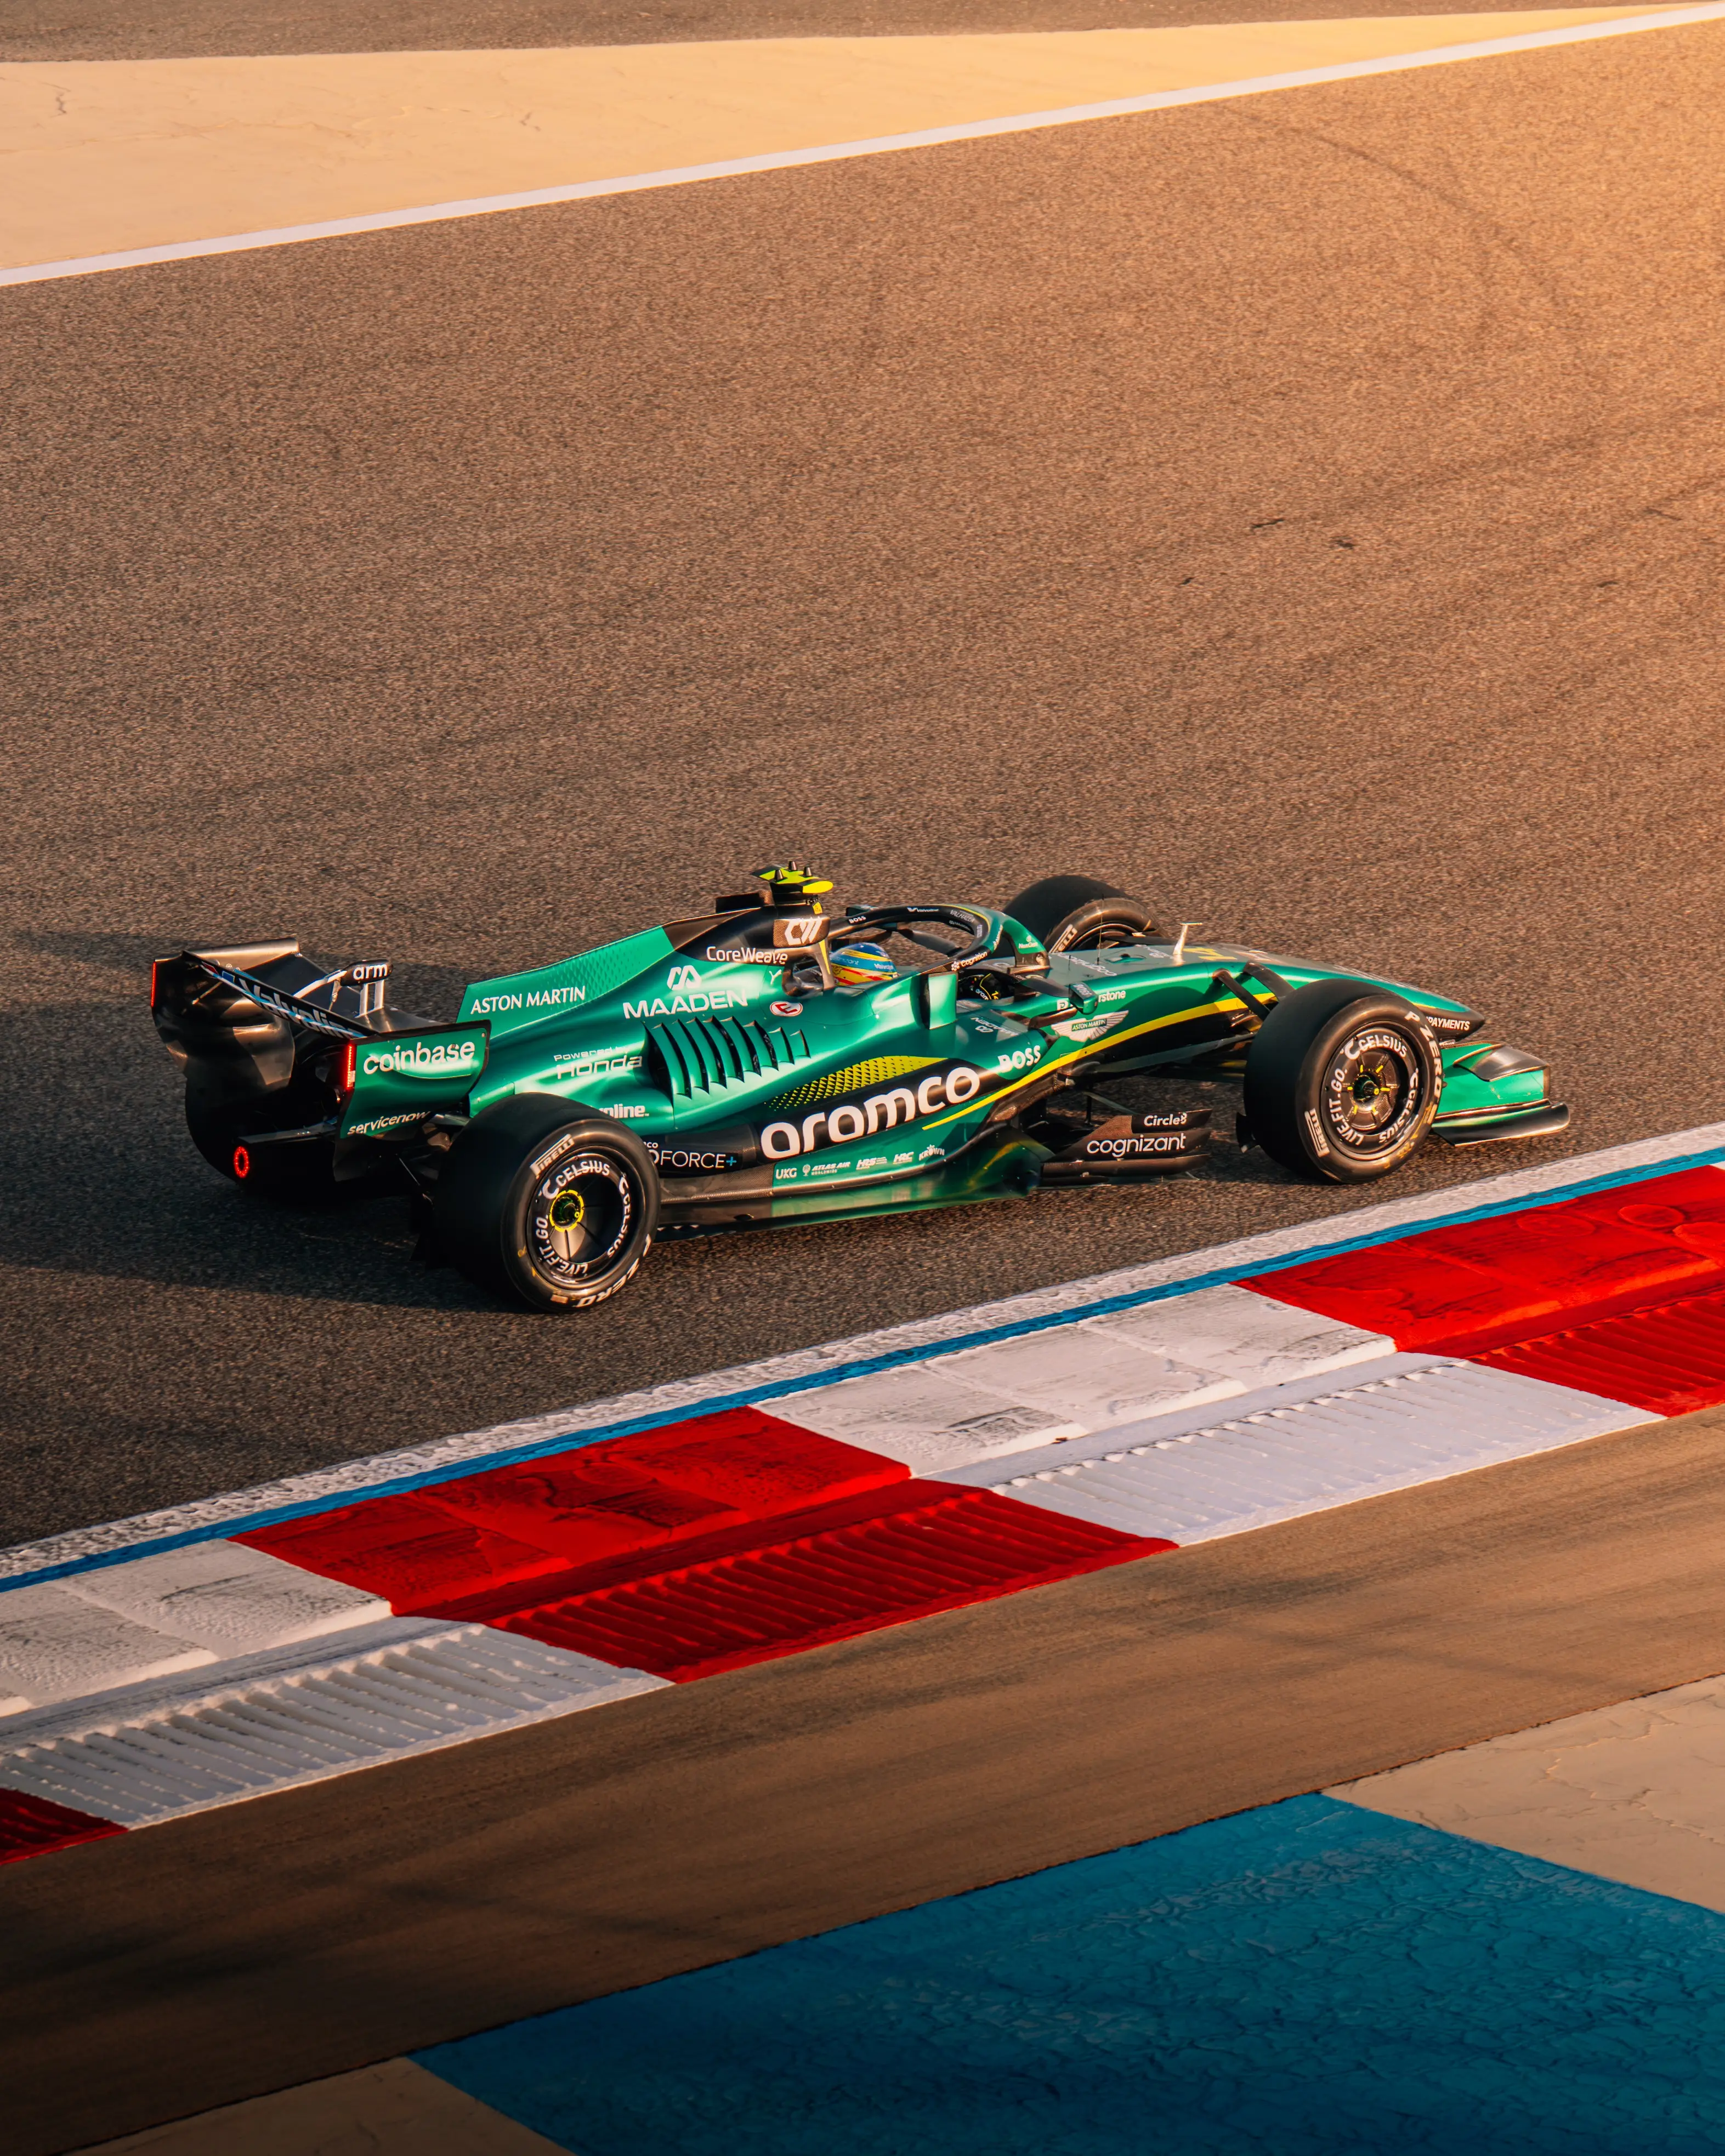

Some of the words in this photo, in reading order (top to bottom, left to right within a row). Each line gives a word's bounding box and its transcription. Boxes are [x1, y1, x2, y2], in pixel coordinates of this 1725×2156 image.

[707, 946, 788, 965] CoreWeave
[961, 952, 988, 967] Cognition
[354, 963, 388, 980] arm
[470, 993, 522, 1014] ASTON
[526, 986, 586, 1007] MARTIN
[623, 989, 747, 1019] MAADEN
[1073, 1023, 1088, 1031] ASTON
[1088, 1019, 1106, 1028] MARTIN
[363, 1041, 475, 1075] coinbase
[554, 1046, 612, 1061] Powered
[1358, 1034, 1406, 1057] CELSIUS
[1404, 1011, 1420, 1022] P
[1420, 1024, 1442, 1099] ZERO
[556, 1055, 642, 1079] Honda
[998, 1045, 1041, 1073] BOSS
[347, 1111, 430, 1135] servicenow
[761, 1067, 980, 1160] aramco
[1379, 1089, 1417, 1143] CELSIUS
[1087, 1133, 1187, 1157] cognizant
[1304, 1108, 1330, 1157] PIRELLI
[530, 1134, 575, 1179] PIRELLI
[812, 1163, 836, 1171] ATLAS
[555, 1160, 610, 1186] CELSIUS
[776, 1168, 797, 1180] UKG
[608, 1194, 631, 1258] CELSIUS
